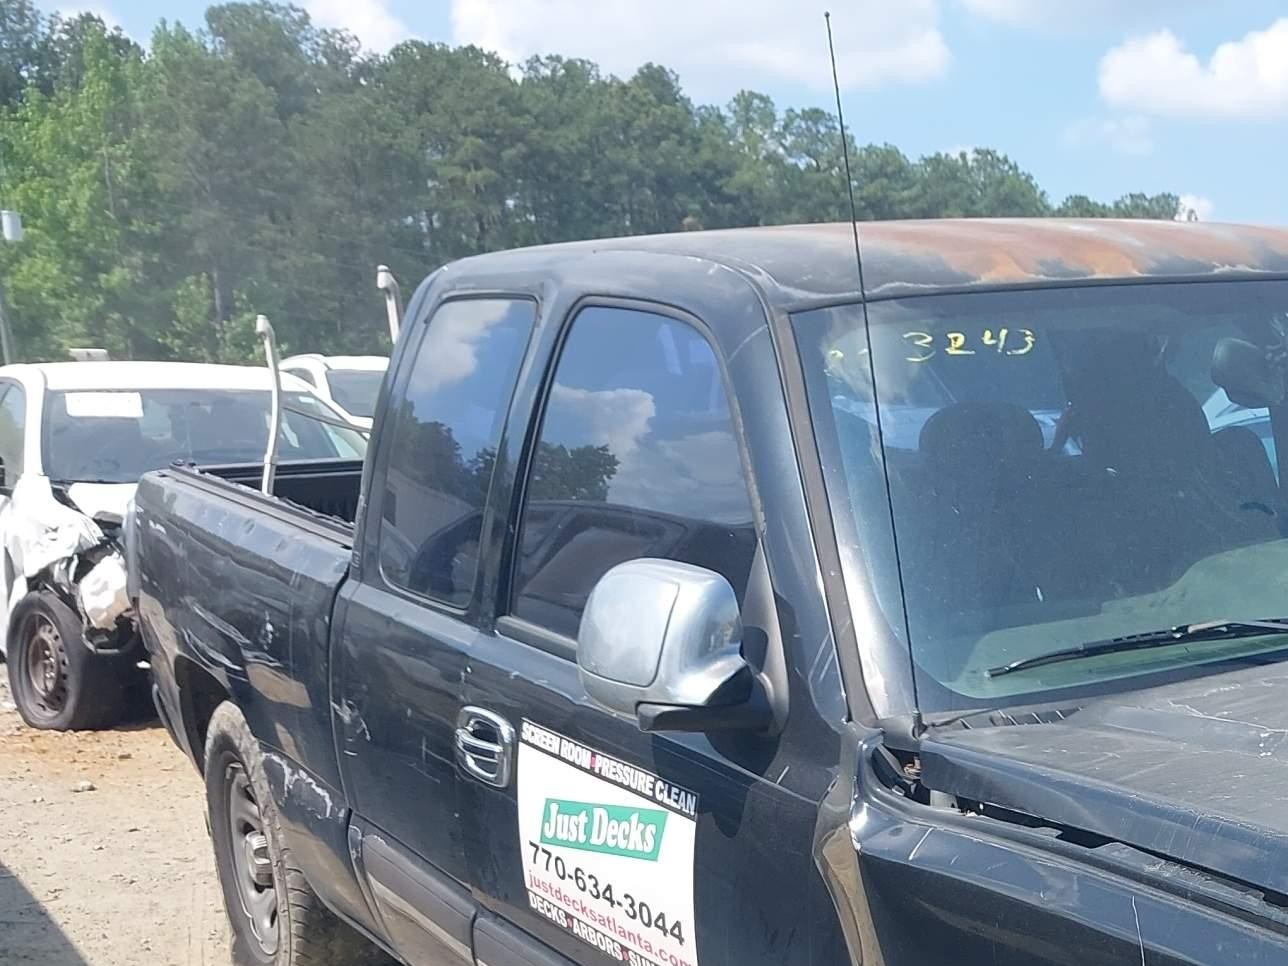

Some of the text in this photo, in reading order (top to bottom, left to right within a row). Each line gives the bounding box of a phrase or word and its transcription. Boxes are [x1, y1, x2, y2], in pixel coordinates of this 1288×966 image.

[521, 722, 697, 815] SCREEN ROOM PRESSURE CLEAN
[544, 802, 658, 853] Just Decks
[529, 841, 686, 945] 770-634-3044
[529, 892, 567, 928] DECKS
[572, 920, 624, 961] ARBORS
